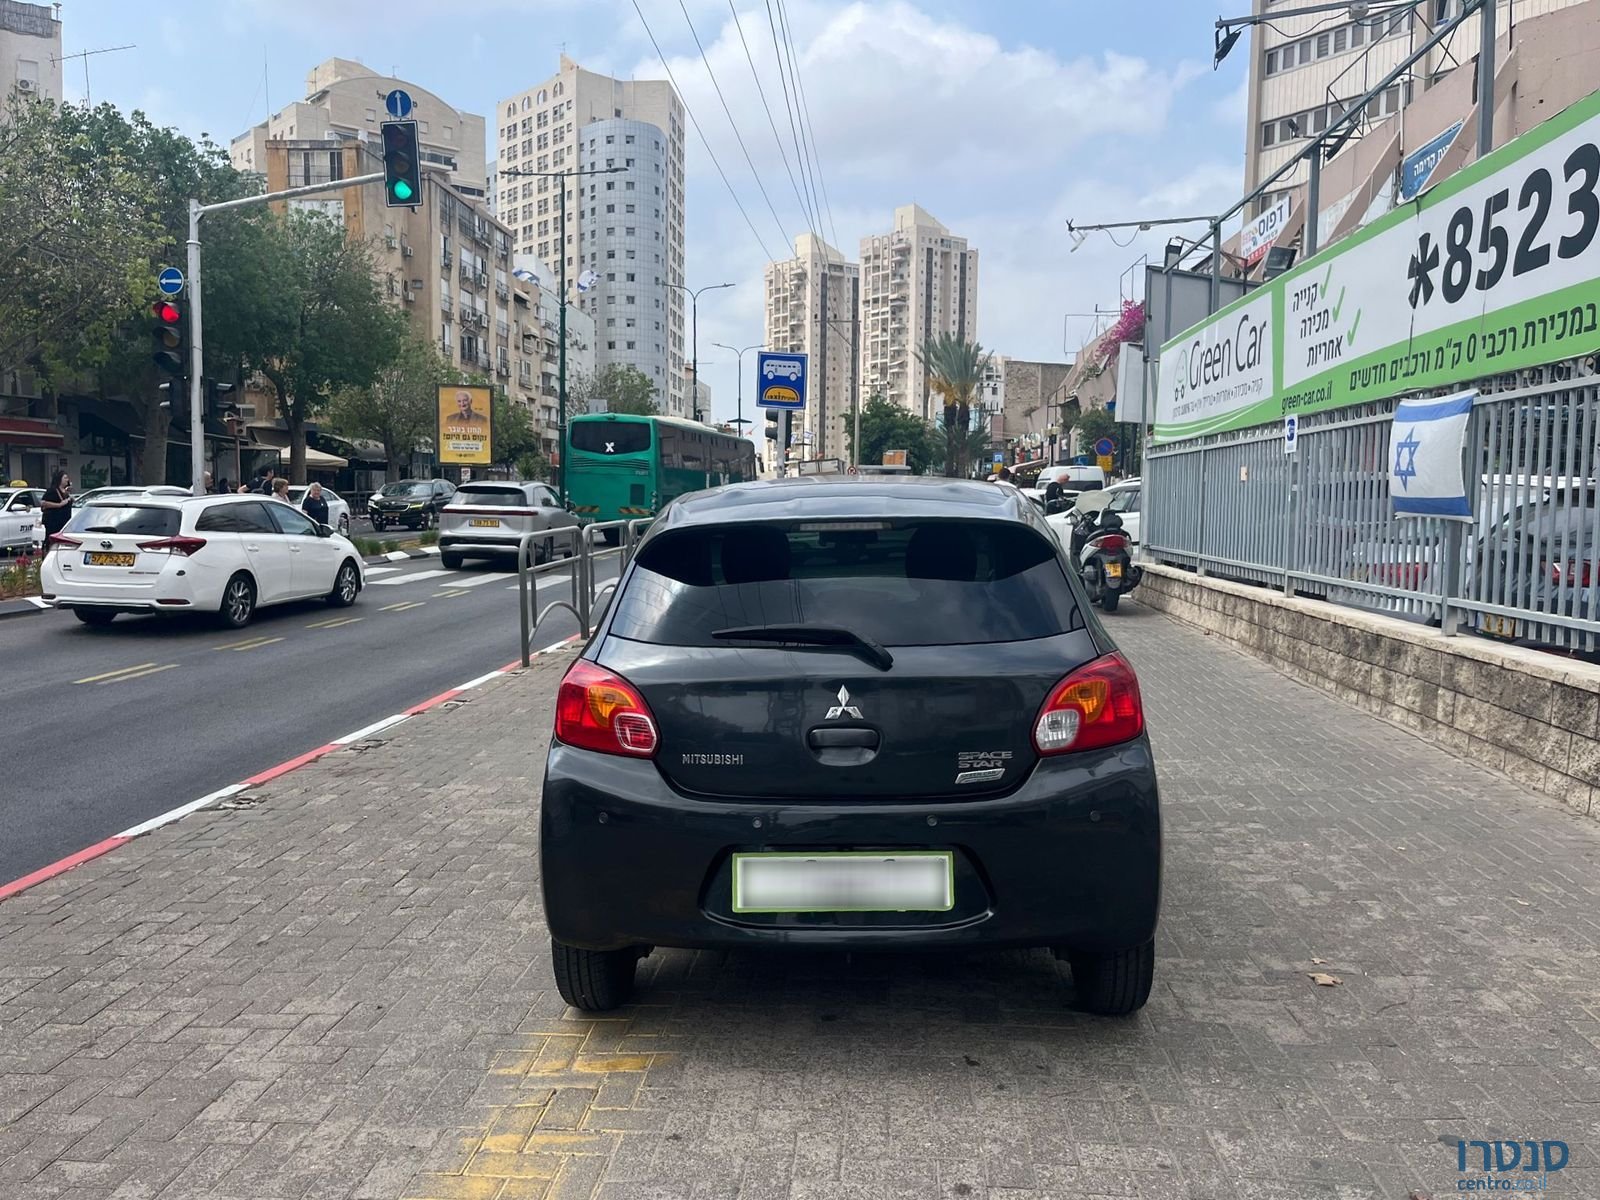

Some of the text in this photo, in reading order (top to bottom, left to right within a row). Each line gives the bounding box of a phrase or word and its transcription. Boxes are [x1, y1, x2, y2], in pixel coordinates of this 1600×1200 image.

[1258, 204, 1284, 237] דפוס
[1292, 282, 1319, 312] קנייה
[1300, 308, 1330, 339] מכירה
[1521, 302, 1598, 349] במכירת
[1189, 314, 1267, 391] Green Car
[1306, 335, 1344, 368] אחריות
[1466, 333, 1476, 364] 0
[1481, 326, 1517, 359] רכבי
[1349, 362, 1387, 392] חדשים
[1389, 346, 1430, 382] ורכבים
[1281, 380, 1333, 415] green-car.co.il
[682, 753, 744, 765] MITSUBISHI
[958, 751, 1013, 760] SPACE
[958, 760, 1003, 768] STAR
